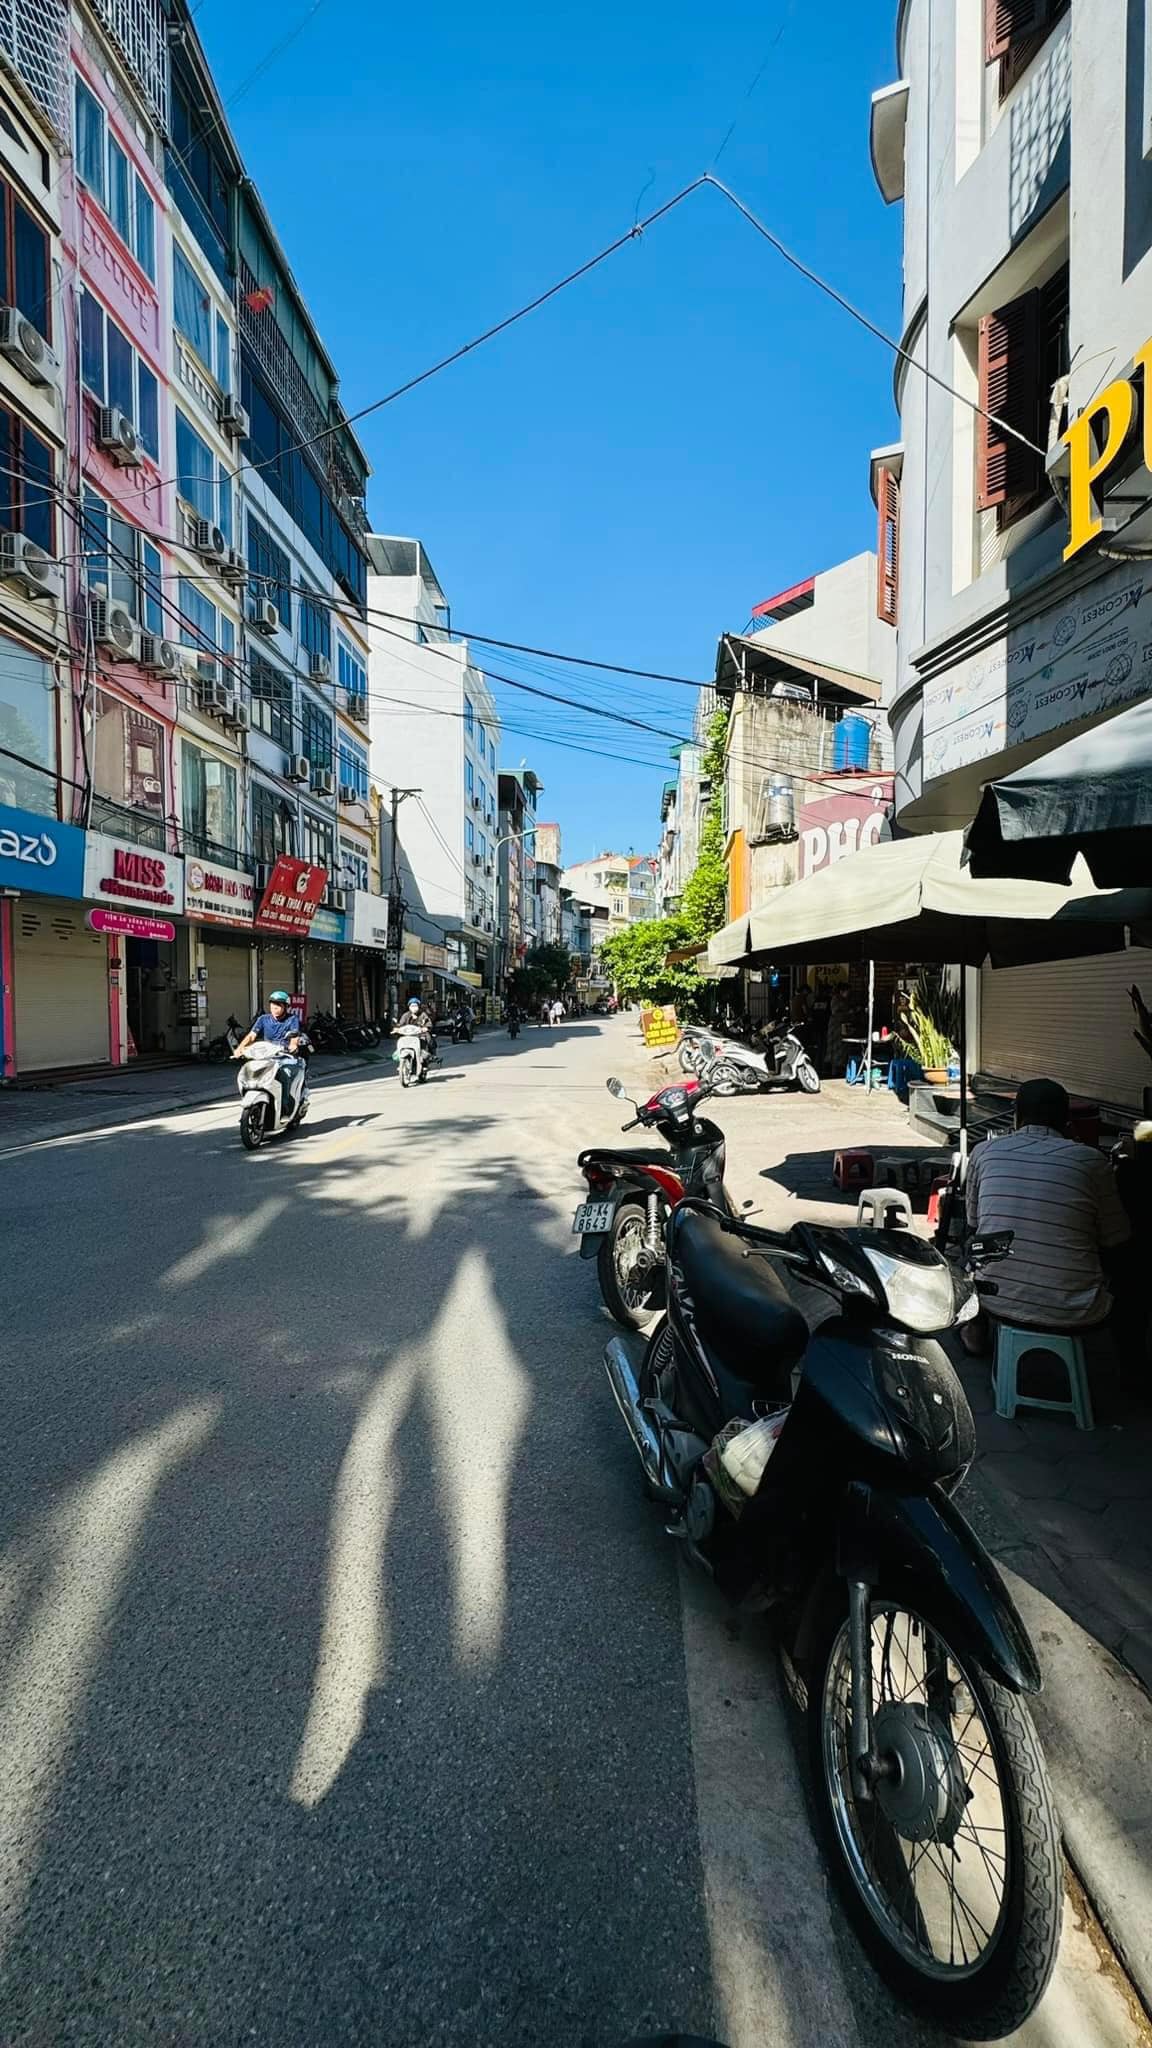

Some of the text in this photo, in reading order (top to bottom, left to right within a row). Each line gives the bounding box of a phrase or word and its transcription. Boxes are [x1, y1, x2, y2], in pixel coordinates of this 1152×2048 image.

[1035, 679, 1089, 710] ALCOREST
[114, 850, 166, 888] MISS
[580, 1204, 609, 1218] 30-K4
[577, 1217, 607, 1231] 8643
[891, 1352, 930, 1365] HONDA
